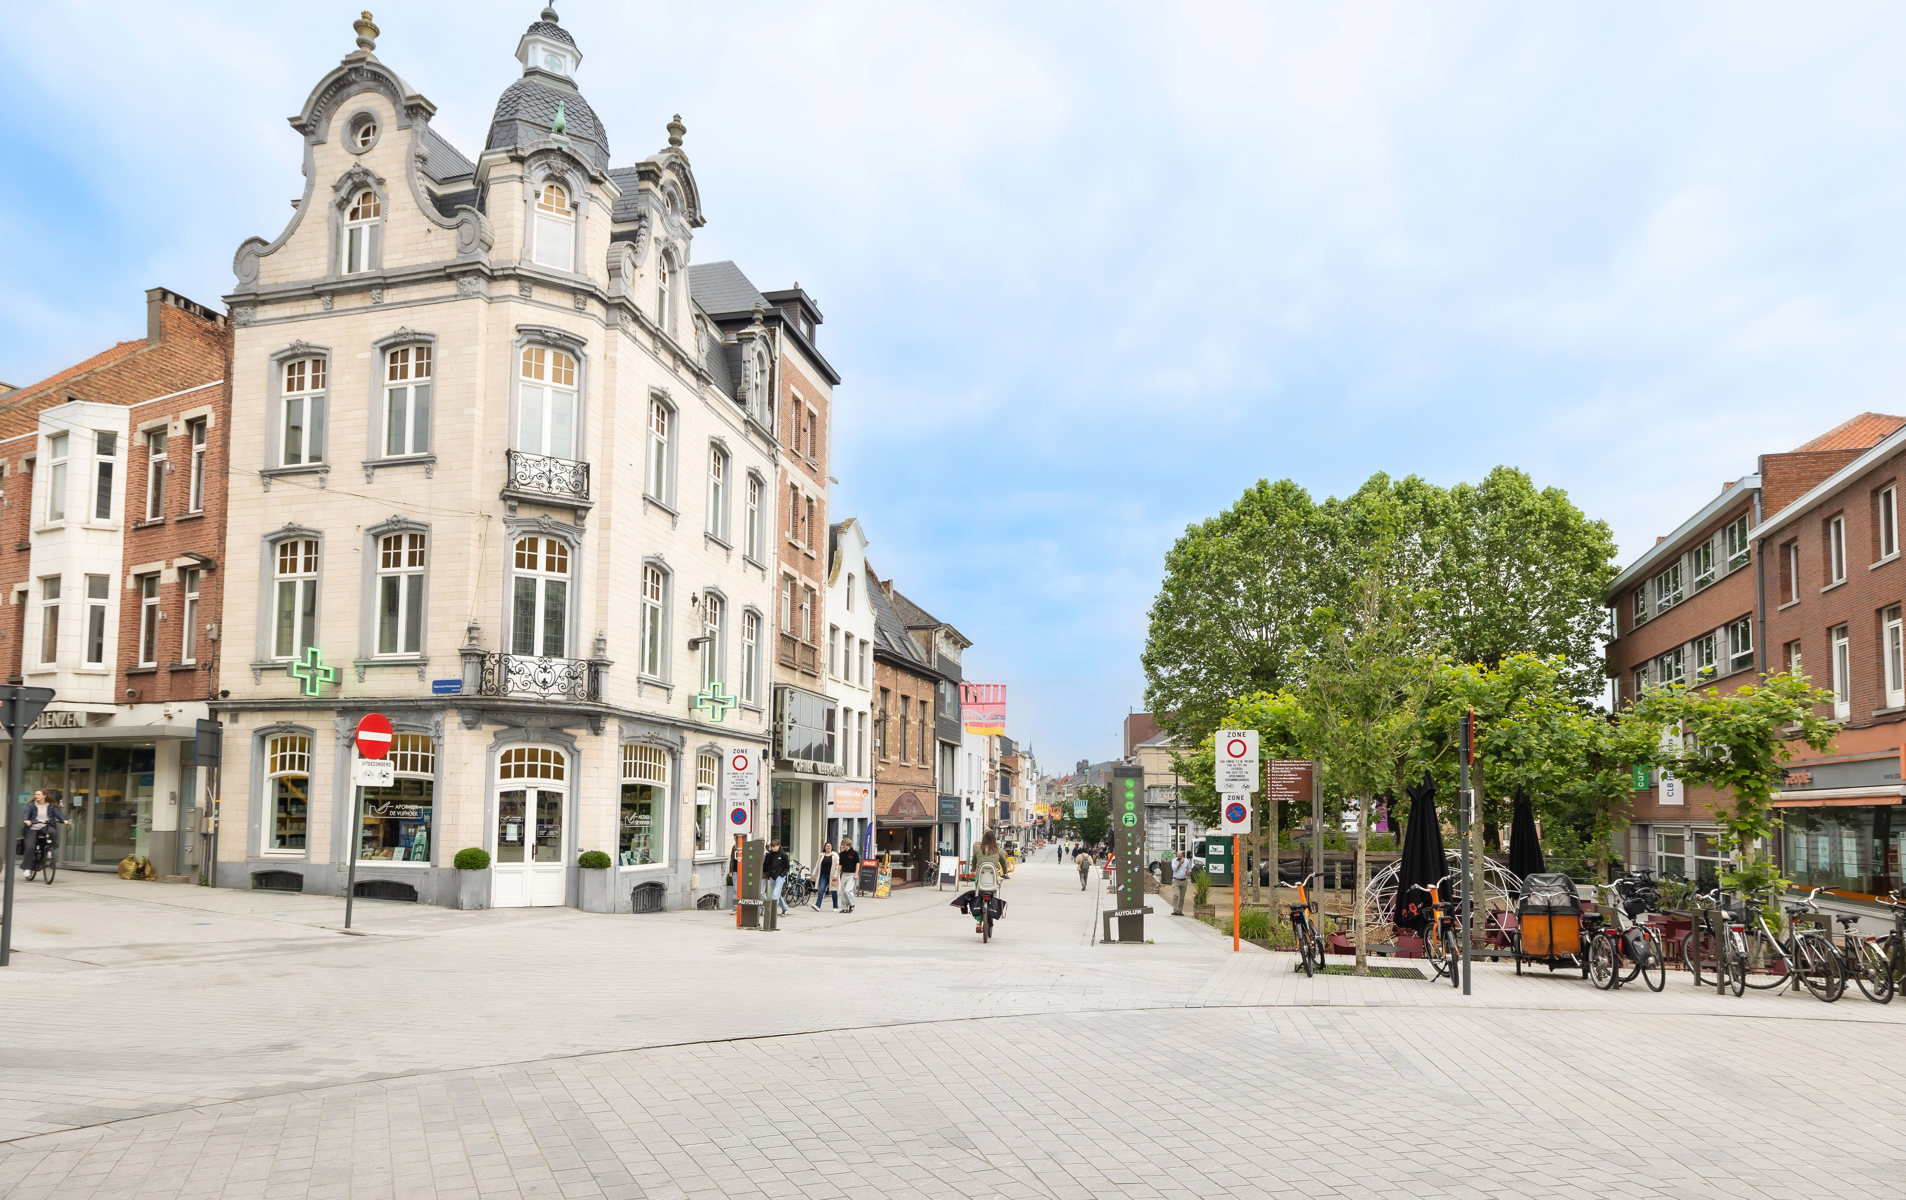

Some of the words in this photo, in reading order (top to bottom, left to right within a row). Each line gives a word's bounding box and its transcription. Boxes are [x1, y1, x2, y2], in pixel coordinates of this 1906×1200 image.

[1666, 782, 1674, 797] CLB
[737, 898, 764, 906] AUTOLUW
[1114, 908, 1142, 917] AUTOLUW
